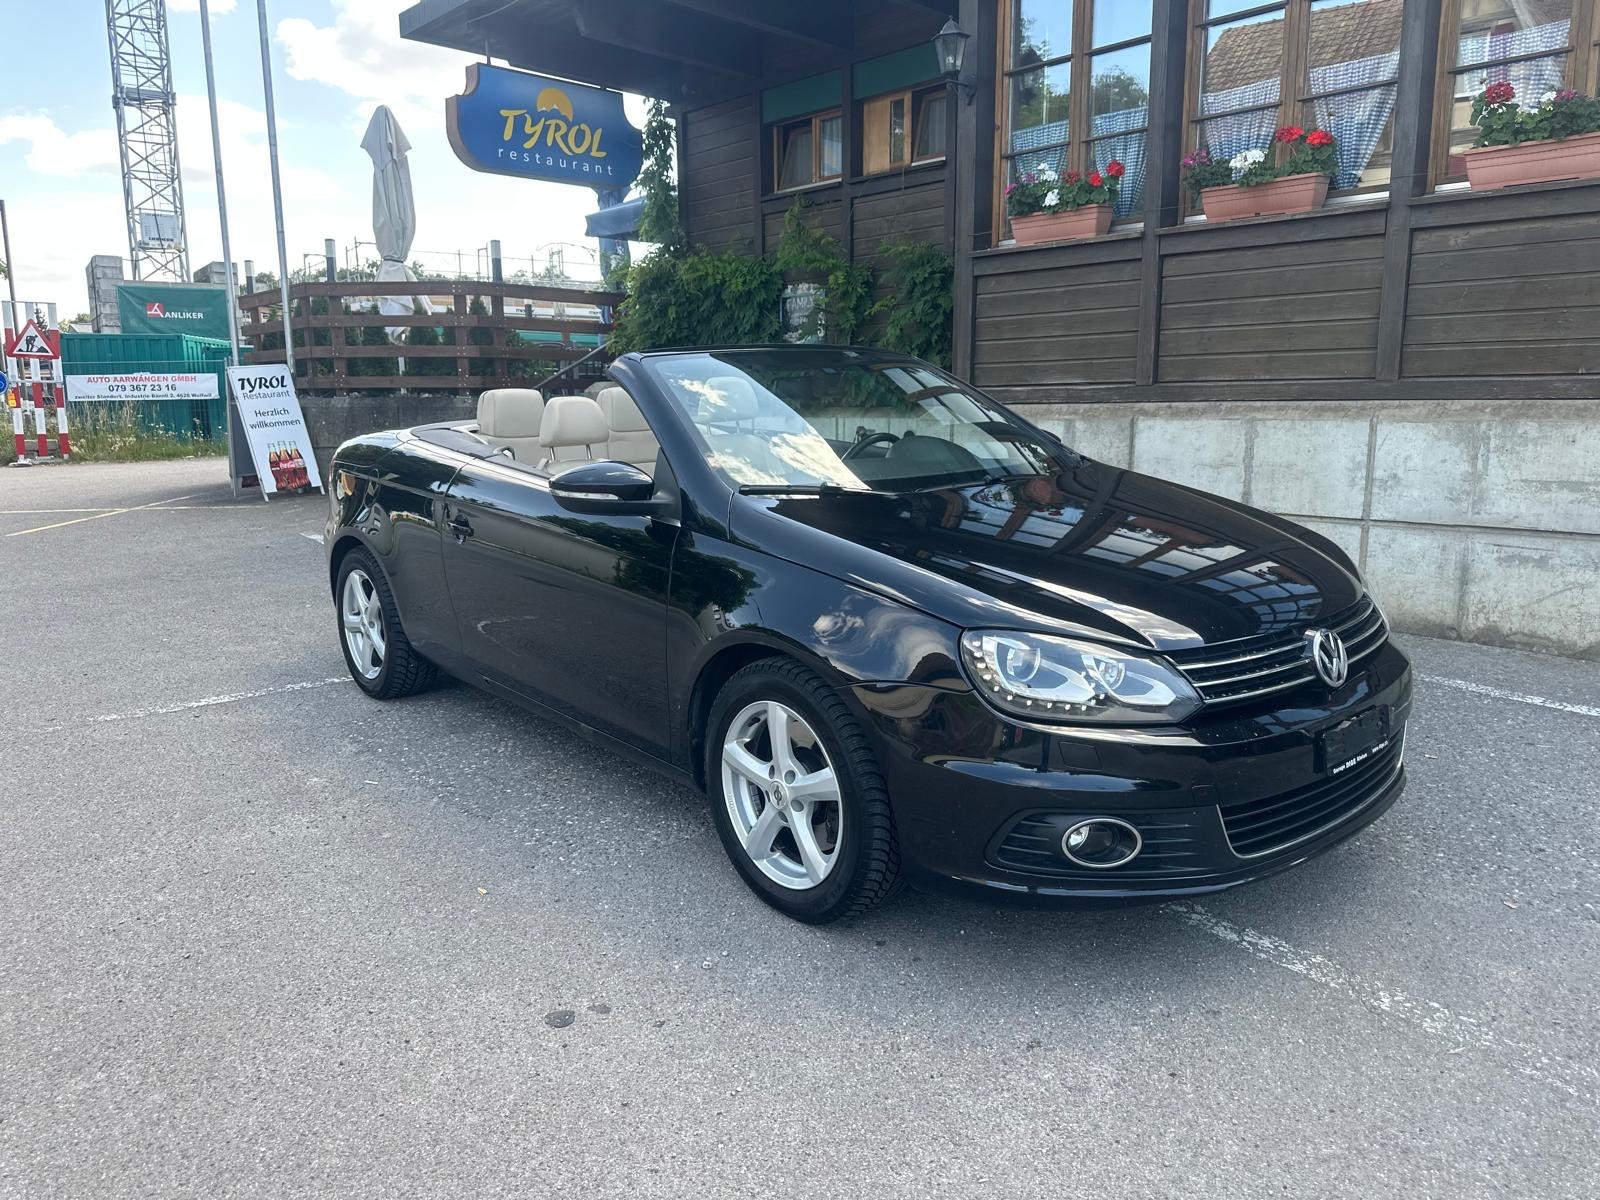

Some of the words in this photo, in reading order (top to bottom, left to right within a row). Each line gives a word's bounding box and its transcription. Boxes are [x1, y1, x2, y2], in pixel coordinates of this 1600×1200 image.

[500, 109, 608, 158] TYROL
[498, 147, 613, 176] restaurant
[164, 311, 204, 319] ANLIKER
[87, 376, 111, 384] AUTO
[237, 375, 288, 393] TYROL
[108, 384, 127, 392] 079
[242, 390, 291, 400] Restaurant
[254, 407, 290, 417] Herzlich
[249, 418, 301, 430] willkommen
